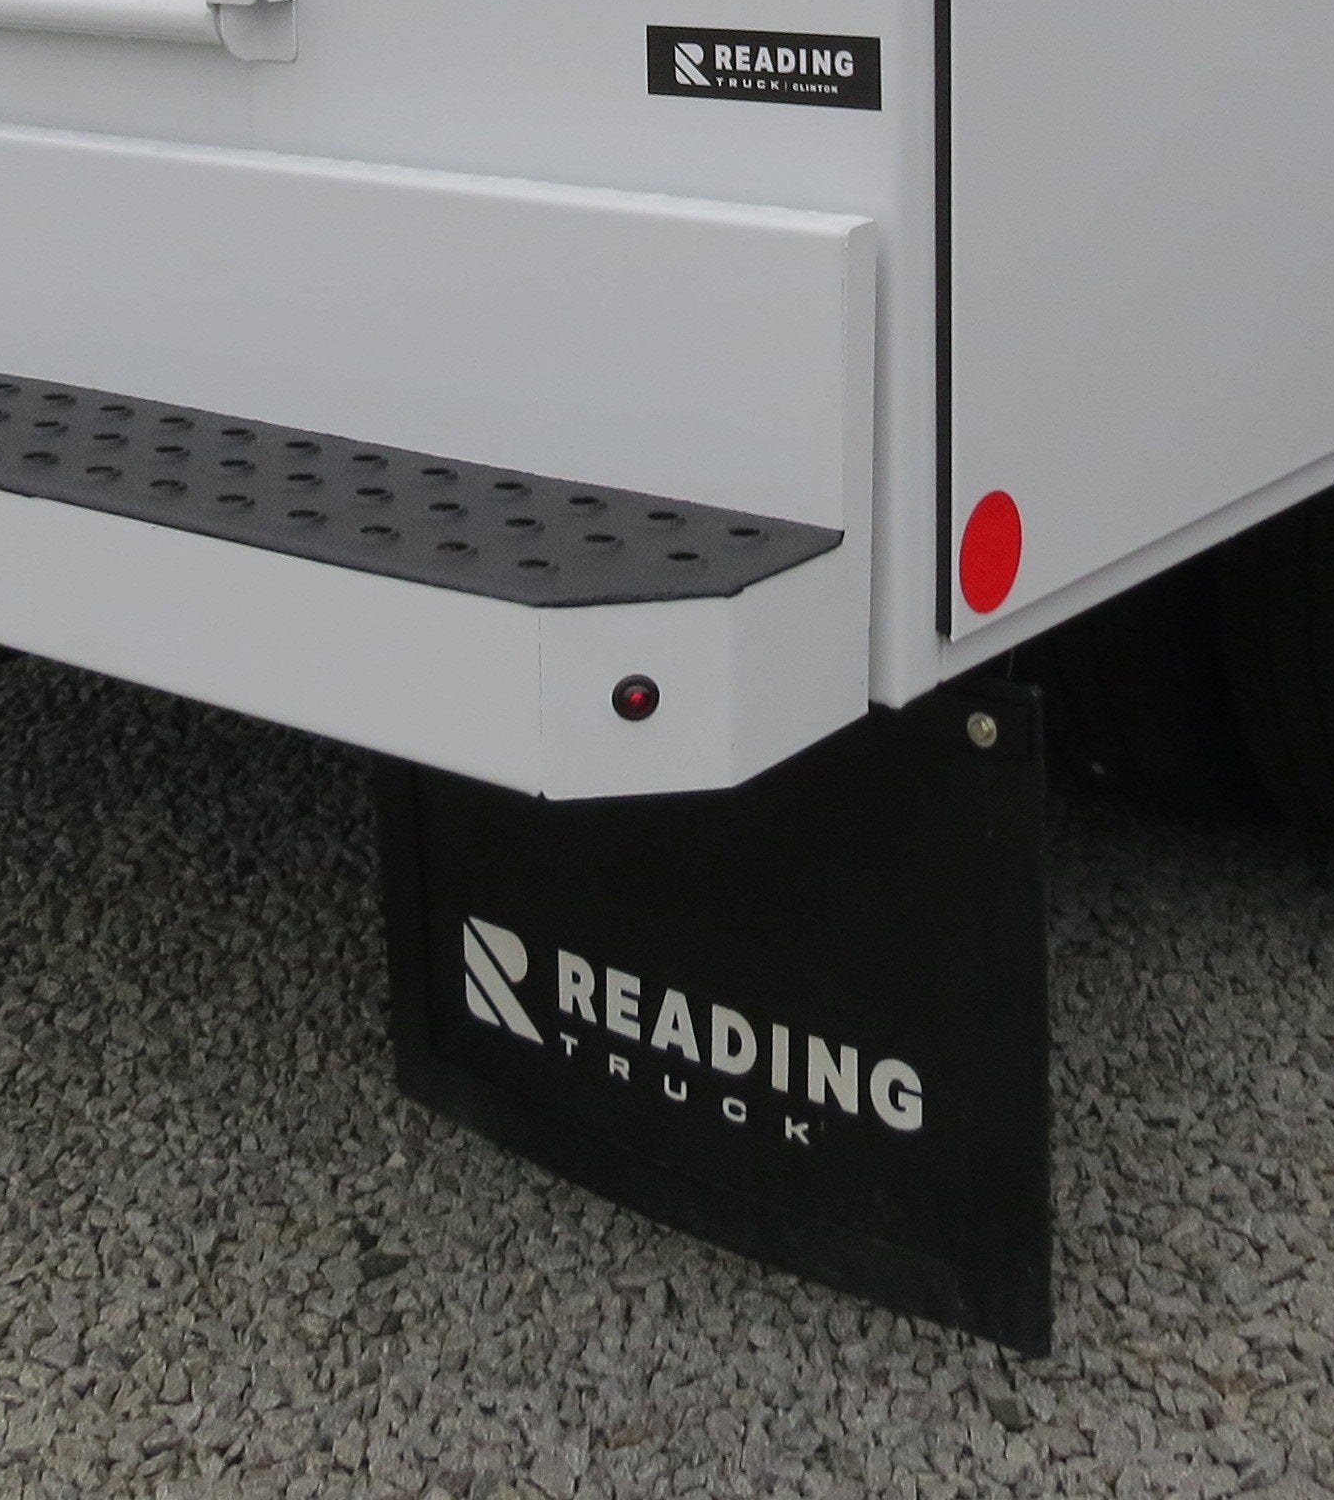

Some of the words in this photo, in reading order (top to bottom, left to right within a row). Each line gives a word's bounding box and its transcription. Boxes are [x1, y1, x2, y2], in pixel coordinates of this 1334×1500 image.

[714, 43, 854, 78] READING
[717, 77, 780, 91] TRUCK
[792, 82, 838, 94] CLINTON
[557, 948, 923, 1132] READING
[559, 1032, 810, 1146] TRUCK
